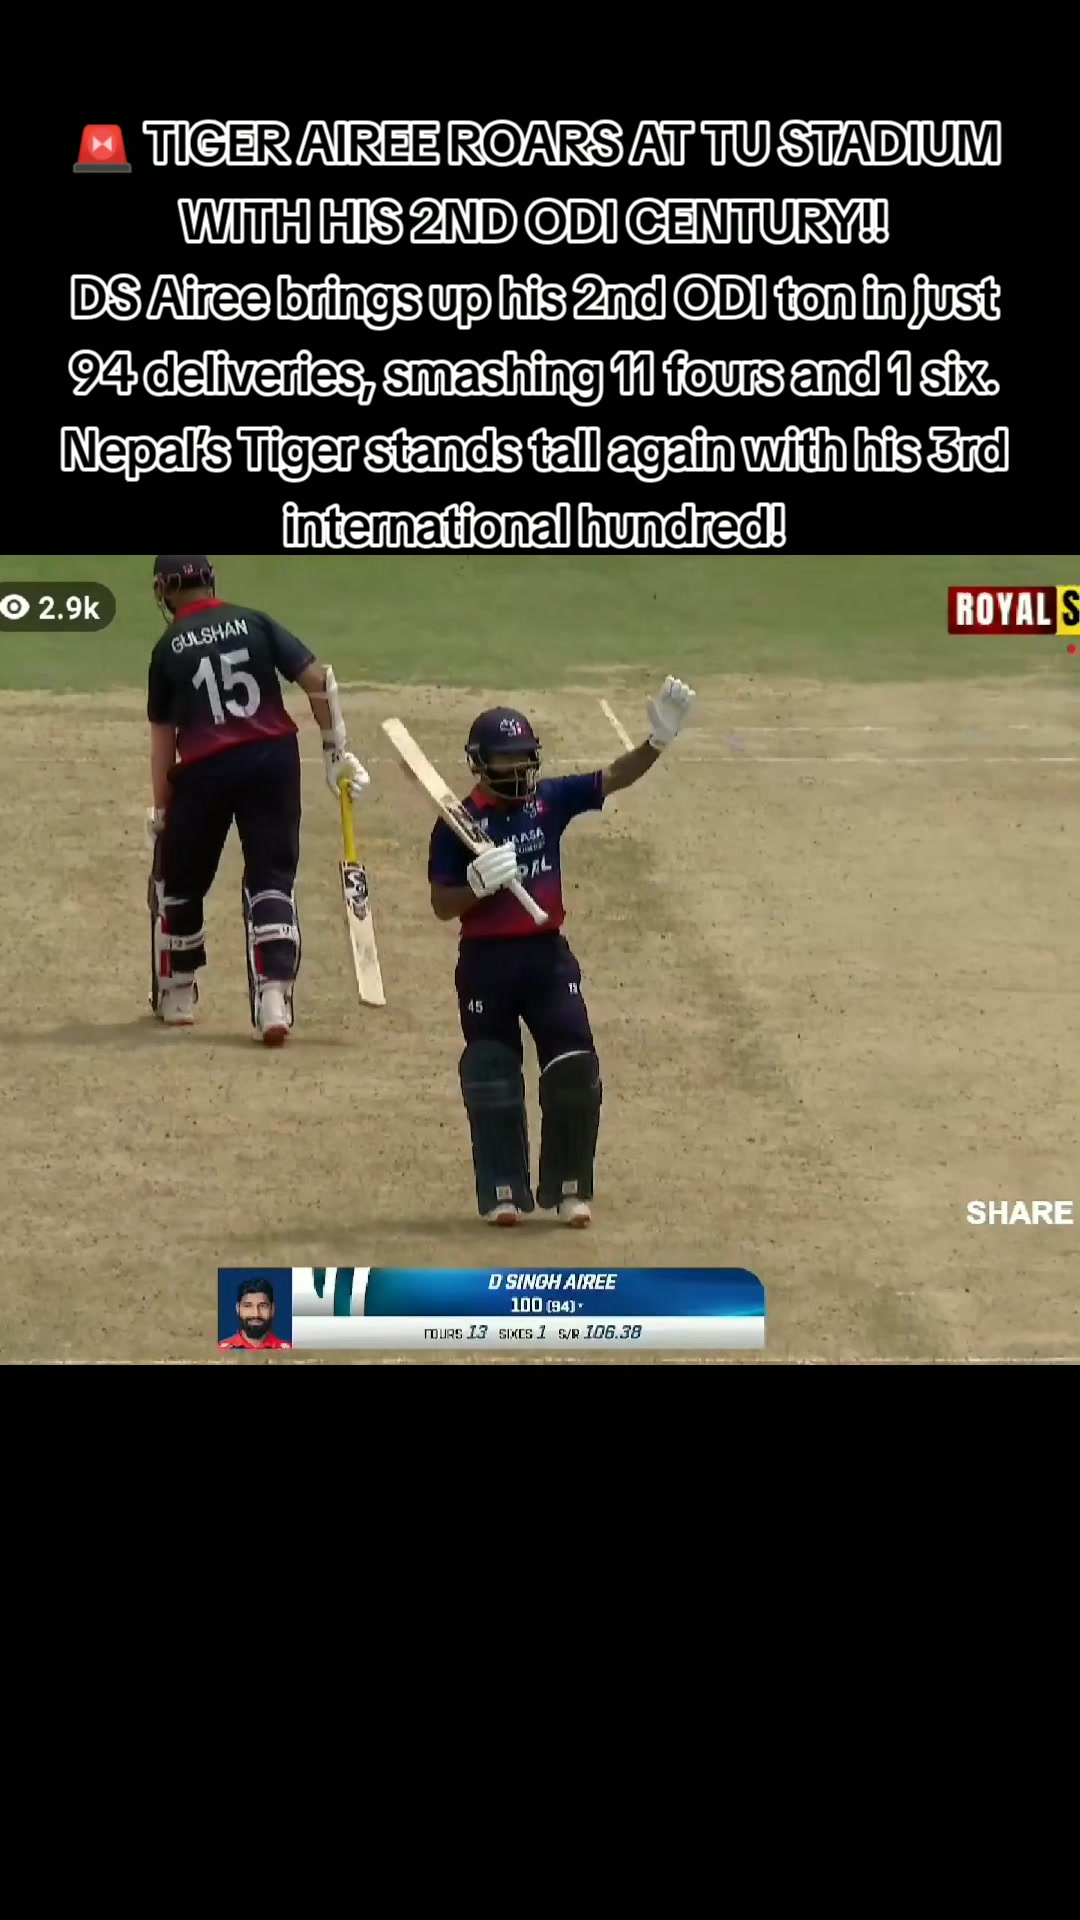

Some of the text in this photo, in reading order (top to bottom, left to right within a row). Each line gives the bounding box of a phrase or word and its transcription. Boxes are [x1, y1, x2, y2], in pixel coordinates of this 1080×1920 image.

[170, 617, 249, 654] GULSHAN
[191, 646, 261, 726] 15
[467, 999, 484, 1014] 45
